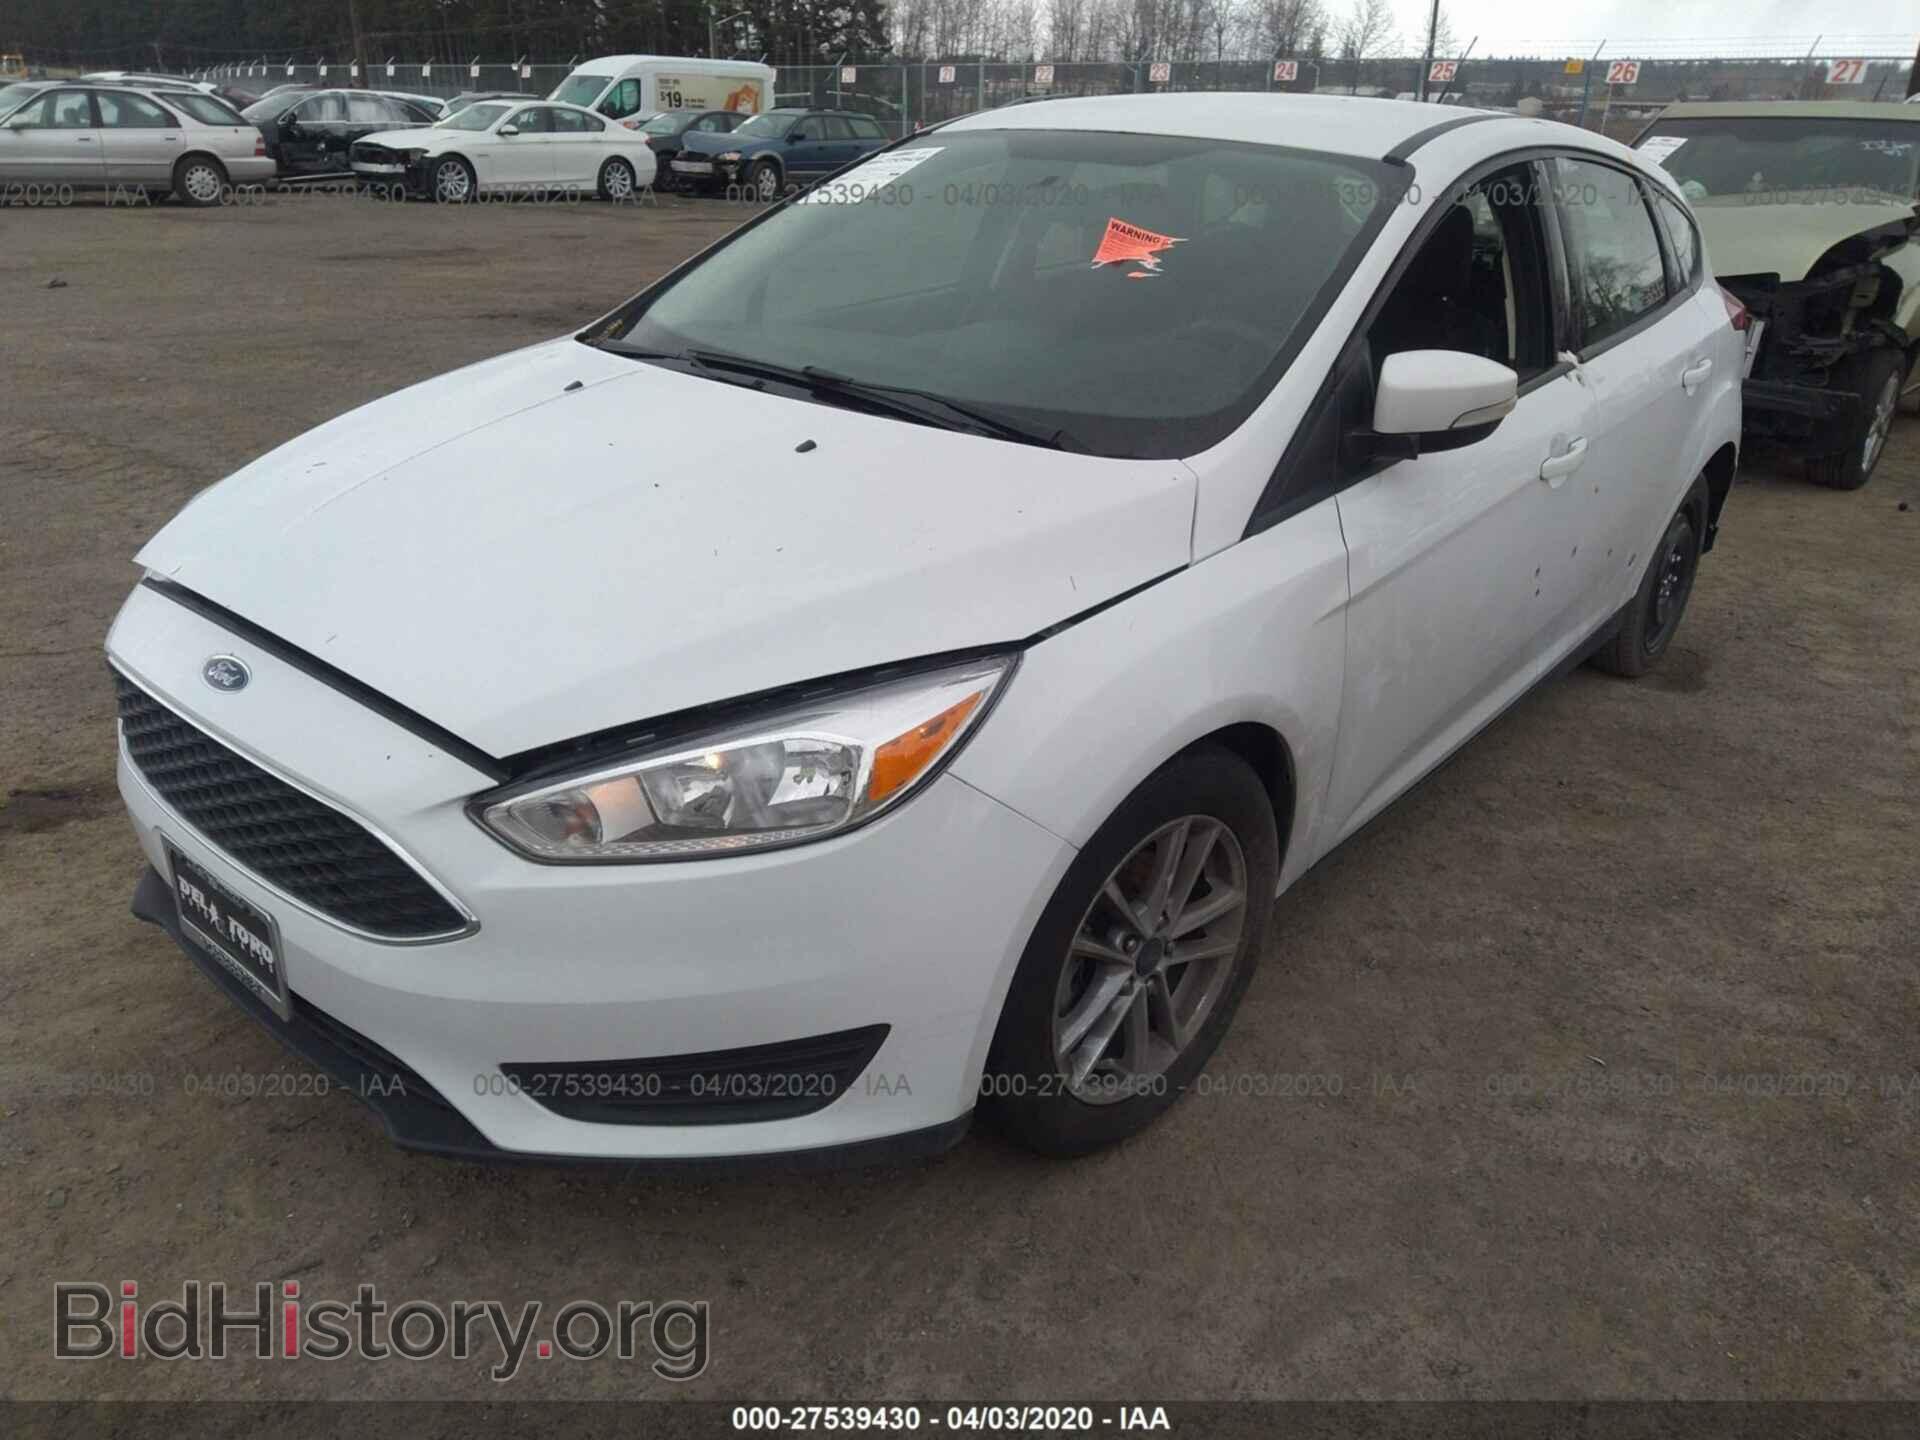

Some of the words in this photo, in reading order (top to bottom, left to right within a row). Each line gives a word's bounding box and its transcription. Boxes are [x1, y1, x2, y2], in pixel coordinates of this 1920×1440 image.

[1151, 64, 1168, 80] 23
[1276, 63, 1295, 80] 24
[1431, 63, 1455, 80] 25
[1610, 63, 1637, 81] 26
[1831, 60, 1863, 81] 27
[660, 91, 682, 108] $19
[1111, 221, 1160, 244] WARNING
